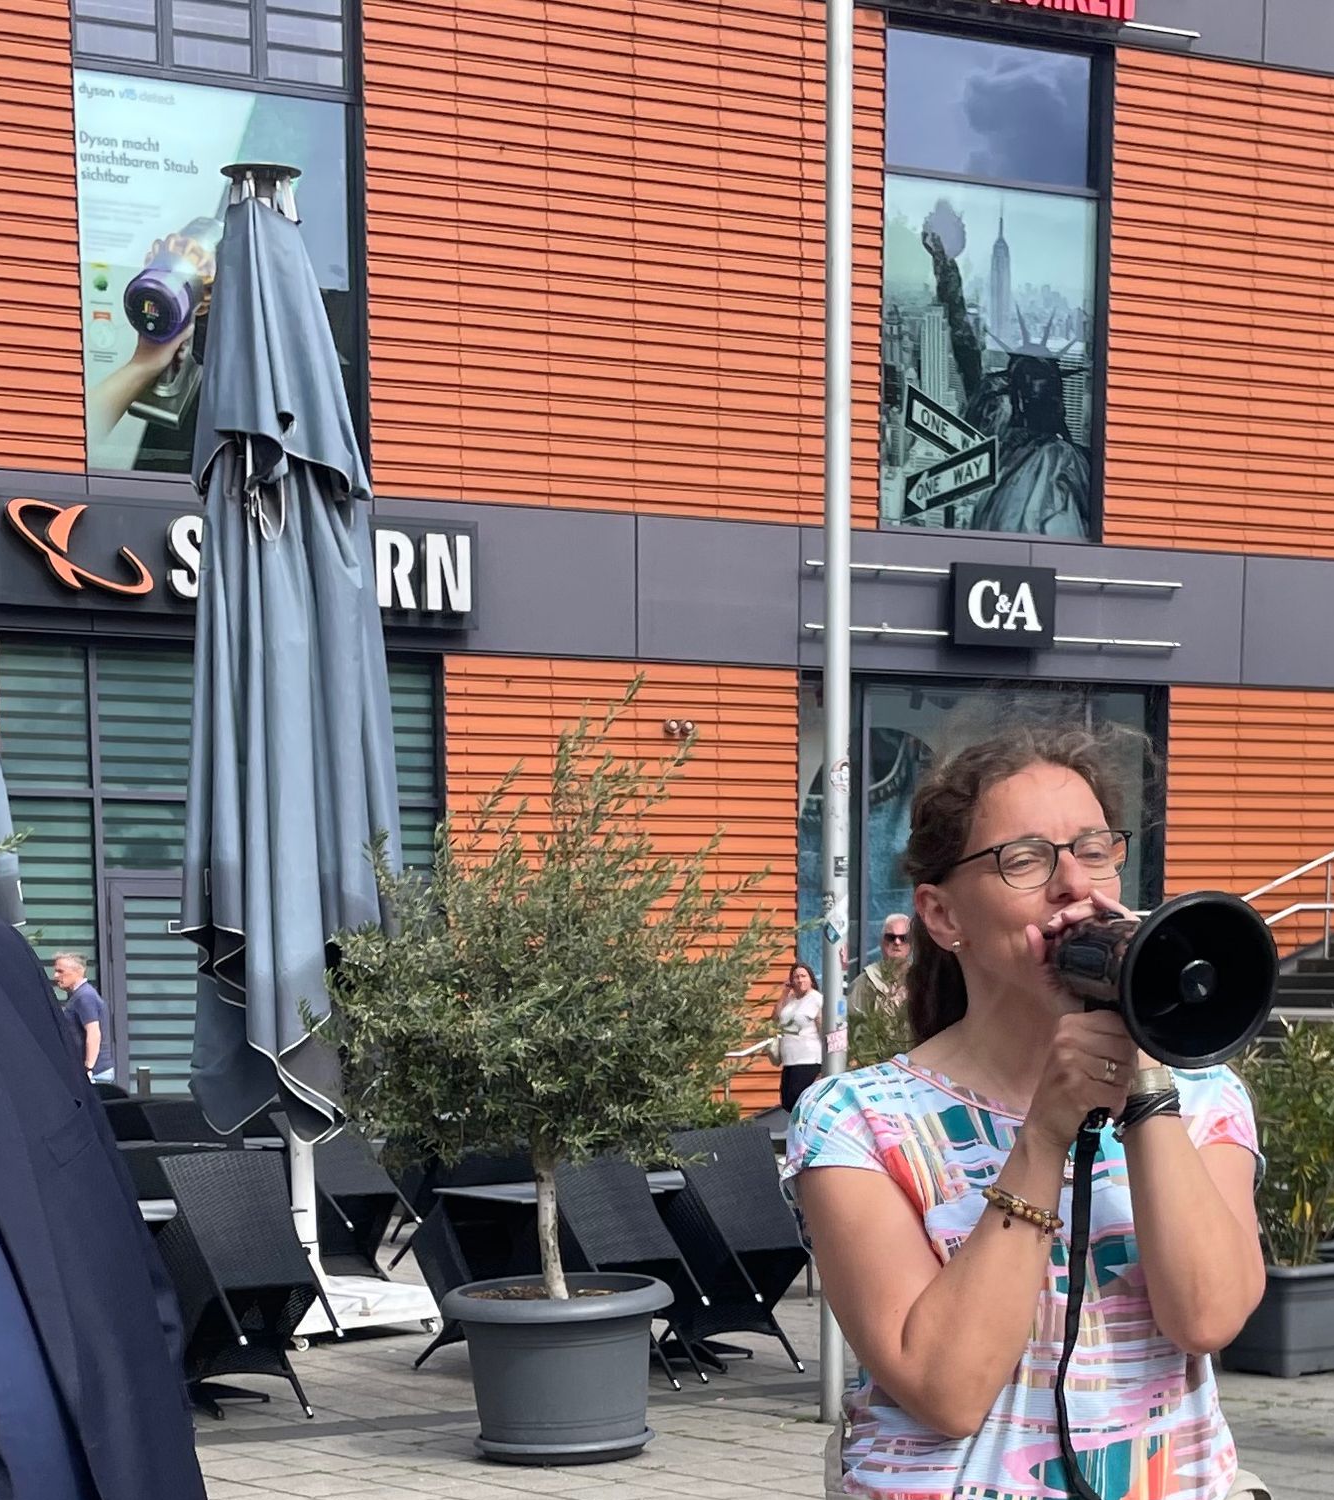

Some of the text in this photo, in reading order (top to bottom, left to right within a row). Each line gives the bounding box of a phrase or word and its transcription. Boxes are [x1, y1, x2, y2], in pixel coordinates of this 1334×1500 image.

[78, 82, 115, 99] dyson
[79, 130, 160, 152] Dyson macht
[80, 150, 199, 175] unsichtbaren Staub
[81, 166, 130, 184] sichtbar
[920, 408, 949, 440] ONE
[915, 458, 984, 501] ONE WAY
[167, 514, 473, 613] SRN
[967, 579, 1043, 633] C&A
